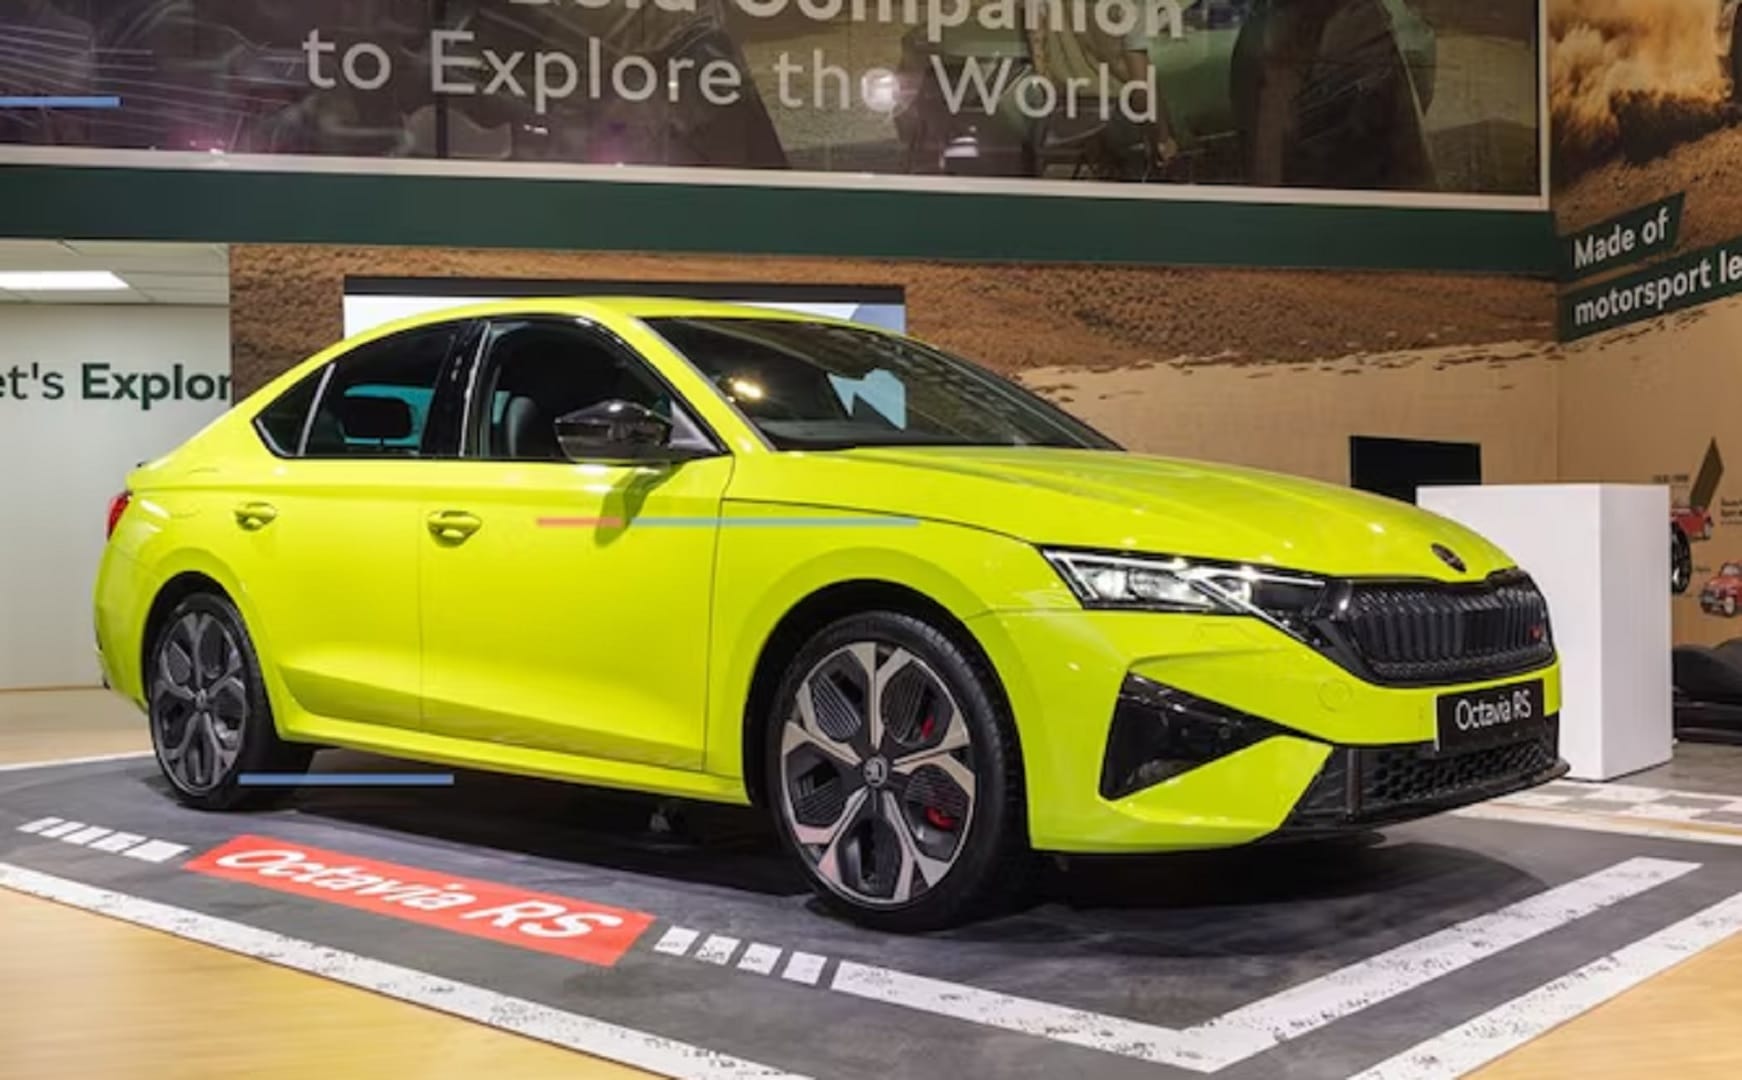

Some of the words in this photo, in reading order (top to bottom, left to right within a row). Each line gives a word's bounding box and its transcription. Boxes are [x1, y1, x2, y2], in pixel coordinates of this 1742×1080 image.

[302, 28, 391, 90] to
[431, 29, 742, 114] Explore
[773, 49, 900, 112] the
[930, 54, 1157, 123] World
[1574, 224, 1635, 269] Made
[1642, 207, 1670, 245] of
[1574, 258, 1712, 325] motorsport
[0, 361, 65, 400] t's
[81, 363, 232, 411] Explor
[1455, 694, 1511, 731] Octavia
[1513, 689, 1532, 719] RS
[215, 848, 476, 911] Octavia
[459, 899, 623, 938] RS
